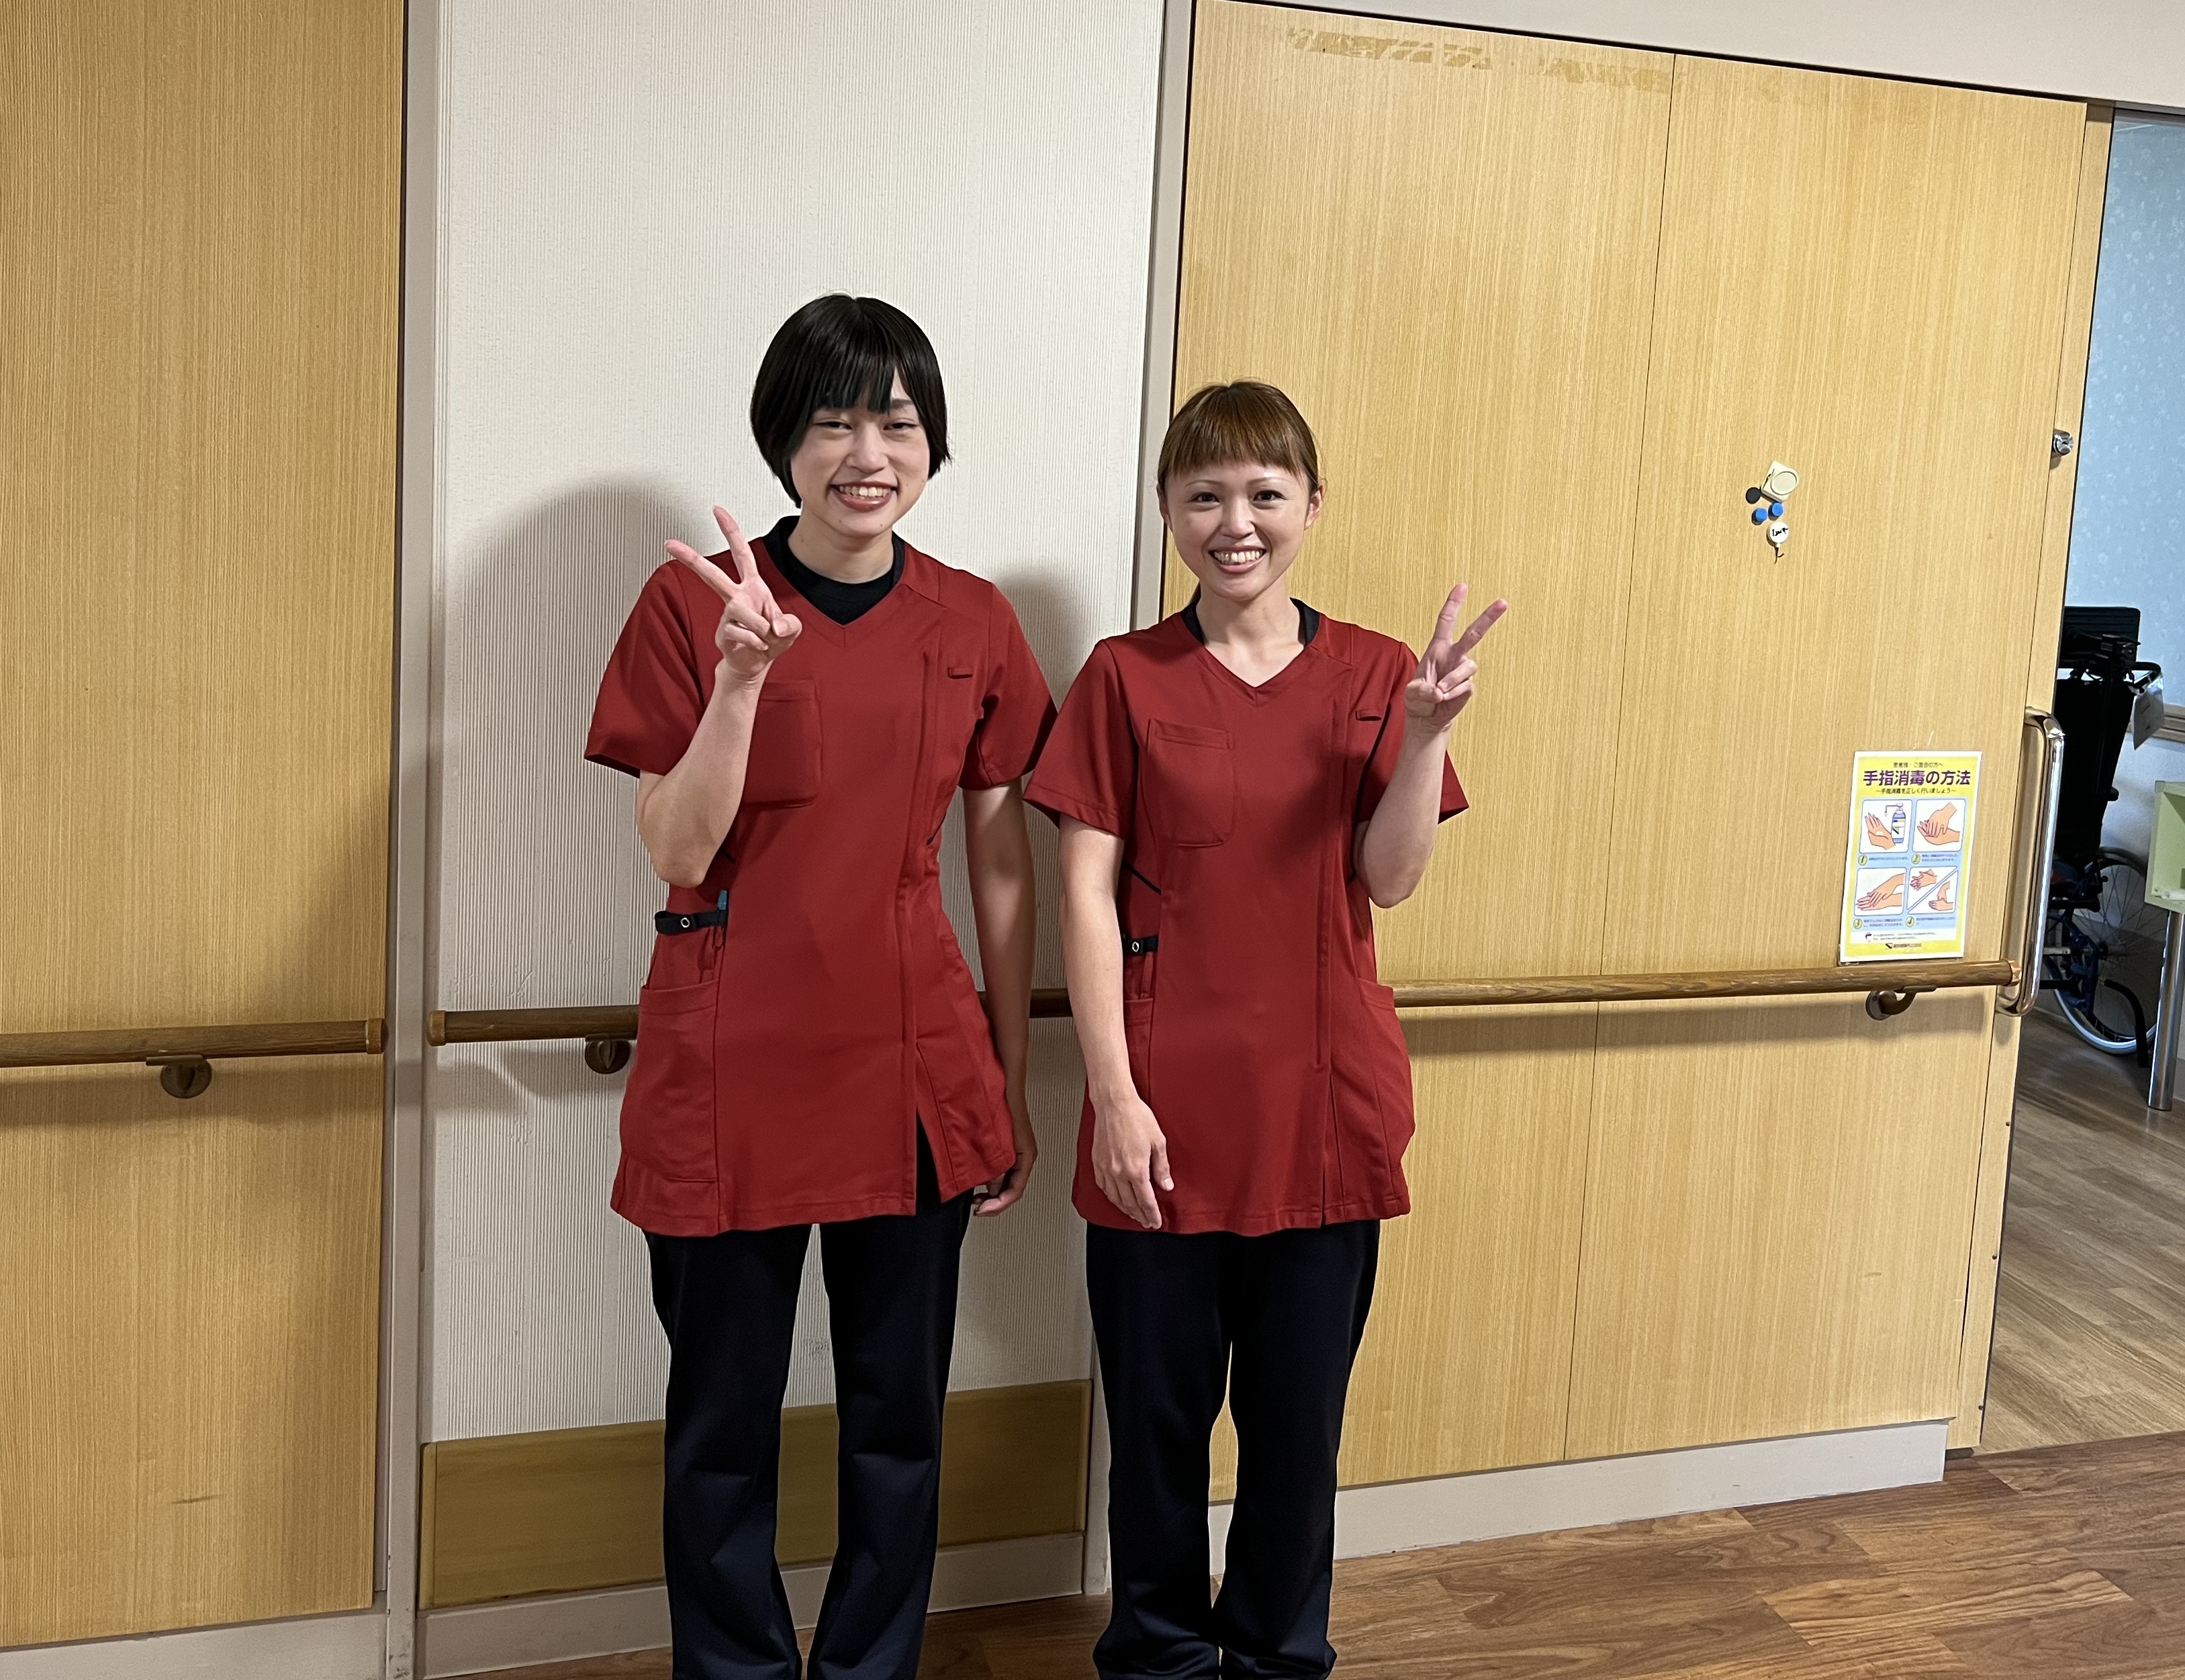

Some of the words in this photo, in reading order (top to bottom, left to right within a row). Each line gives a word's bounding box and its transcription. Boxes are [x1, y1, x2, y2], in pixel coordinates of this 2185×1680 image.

[1863, 769, 1971, 786] 手指消毒の方法
